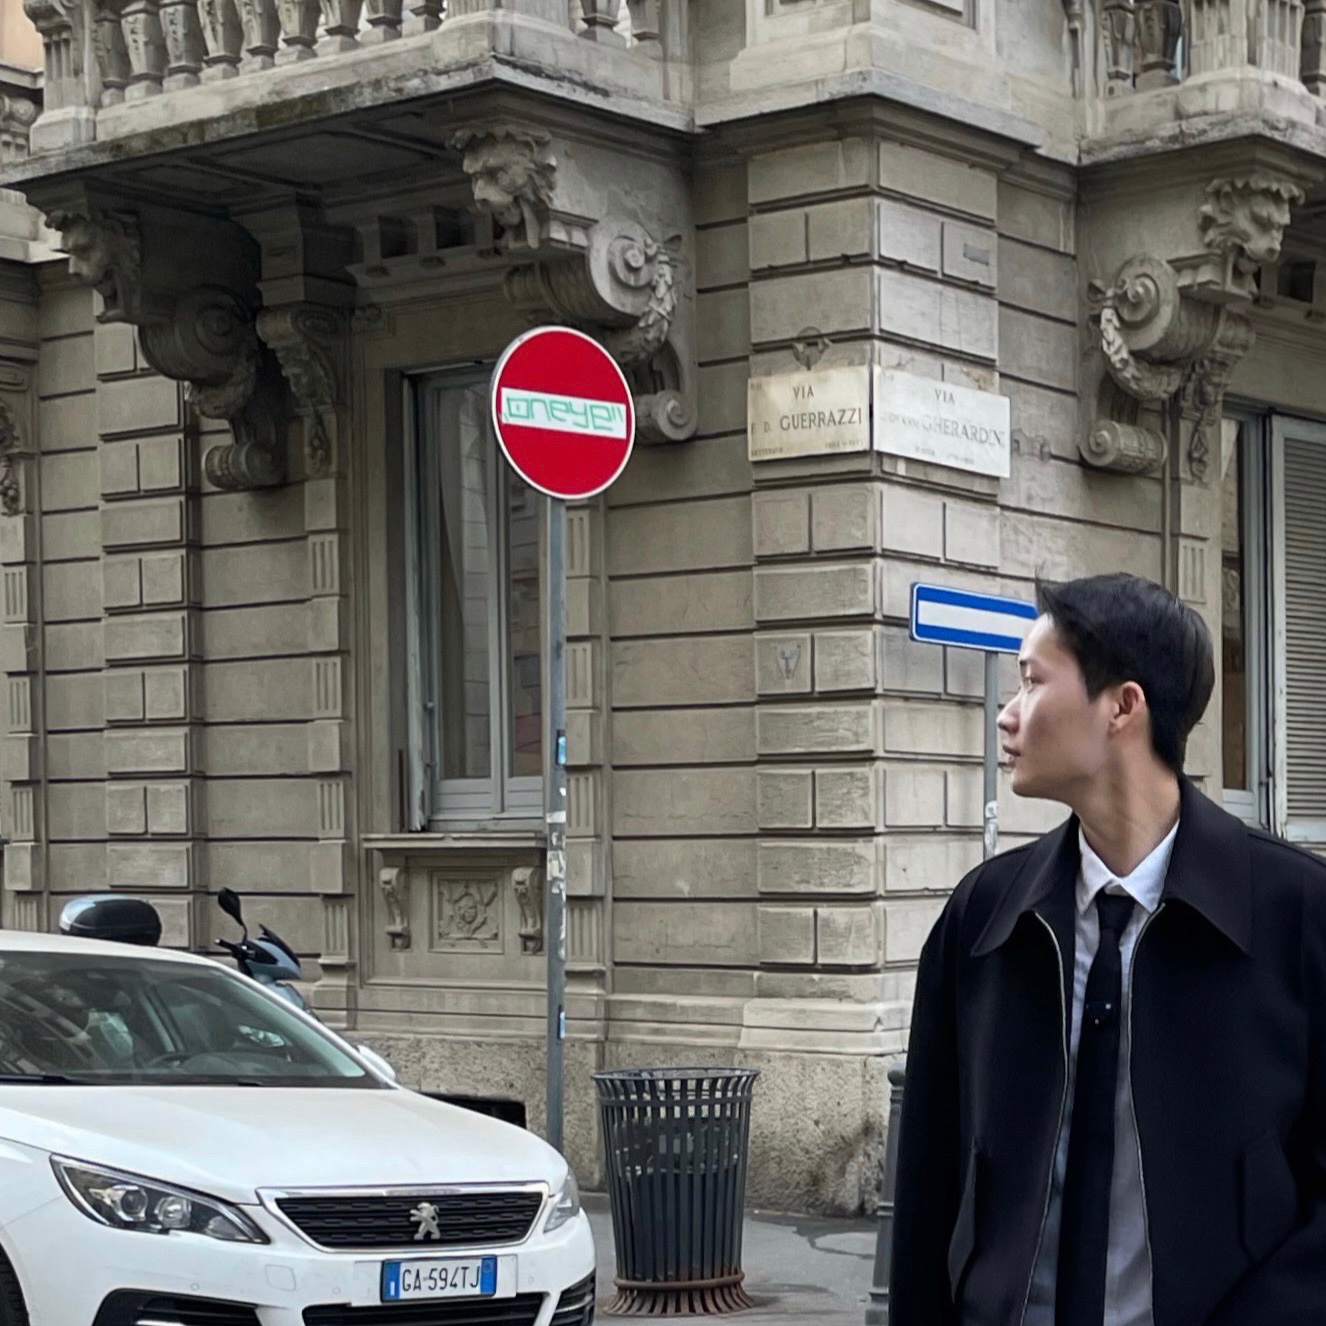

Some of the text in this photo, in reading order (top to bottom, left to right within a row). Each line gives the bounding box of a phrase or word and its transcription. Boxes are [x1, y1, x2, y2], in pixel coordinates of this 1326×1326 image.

[792, 385, 815, 400] VIA
[934, 388, 955, 405] VIA
[779, 407, 862, 432] GUERRAZZI
